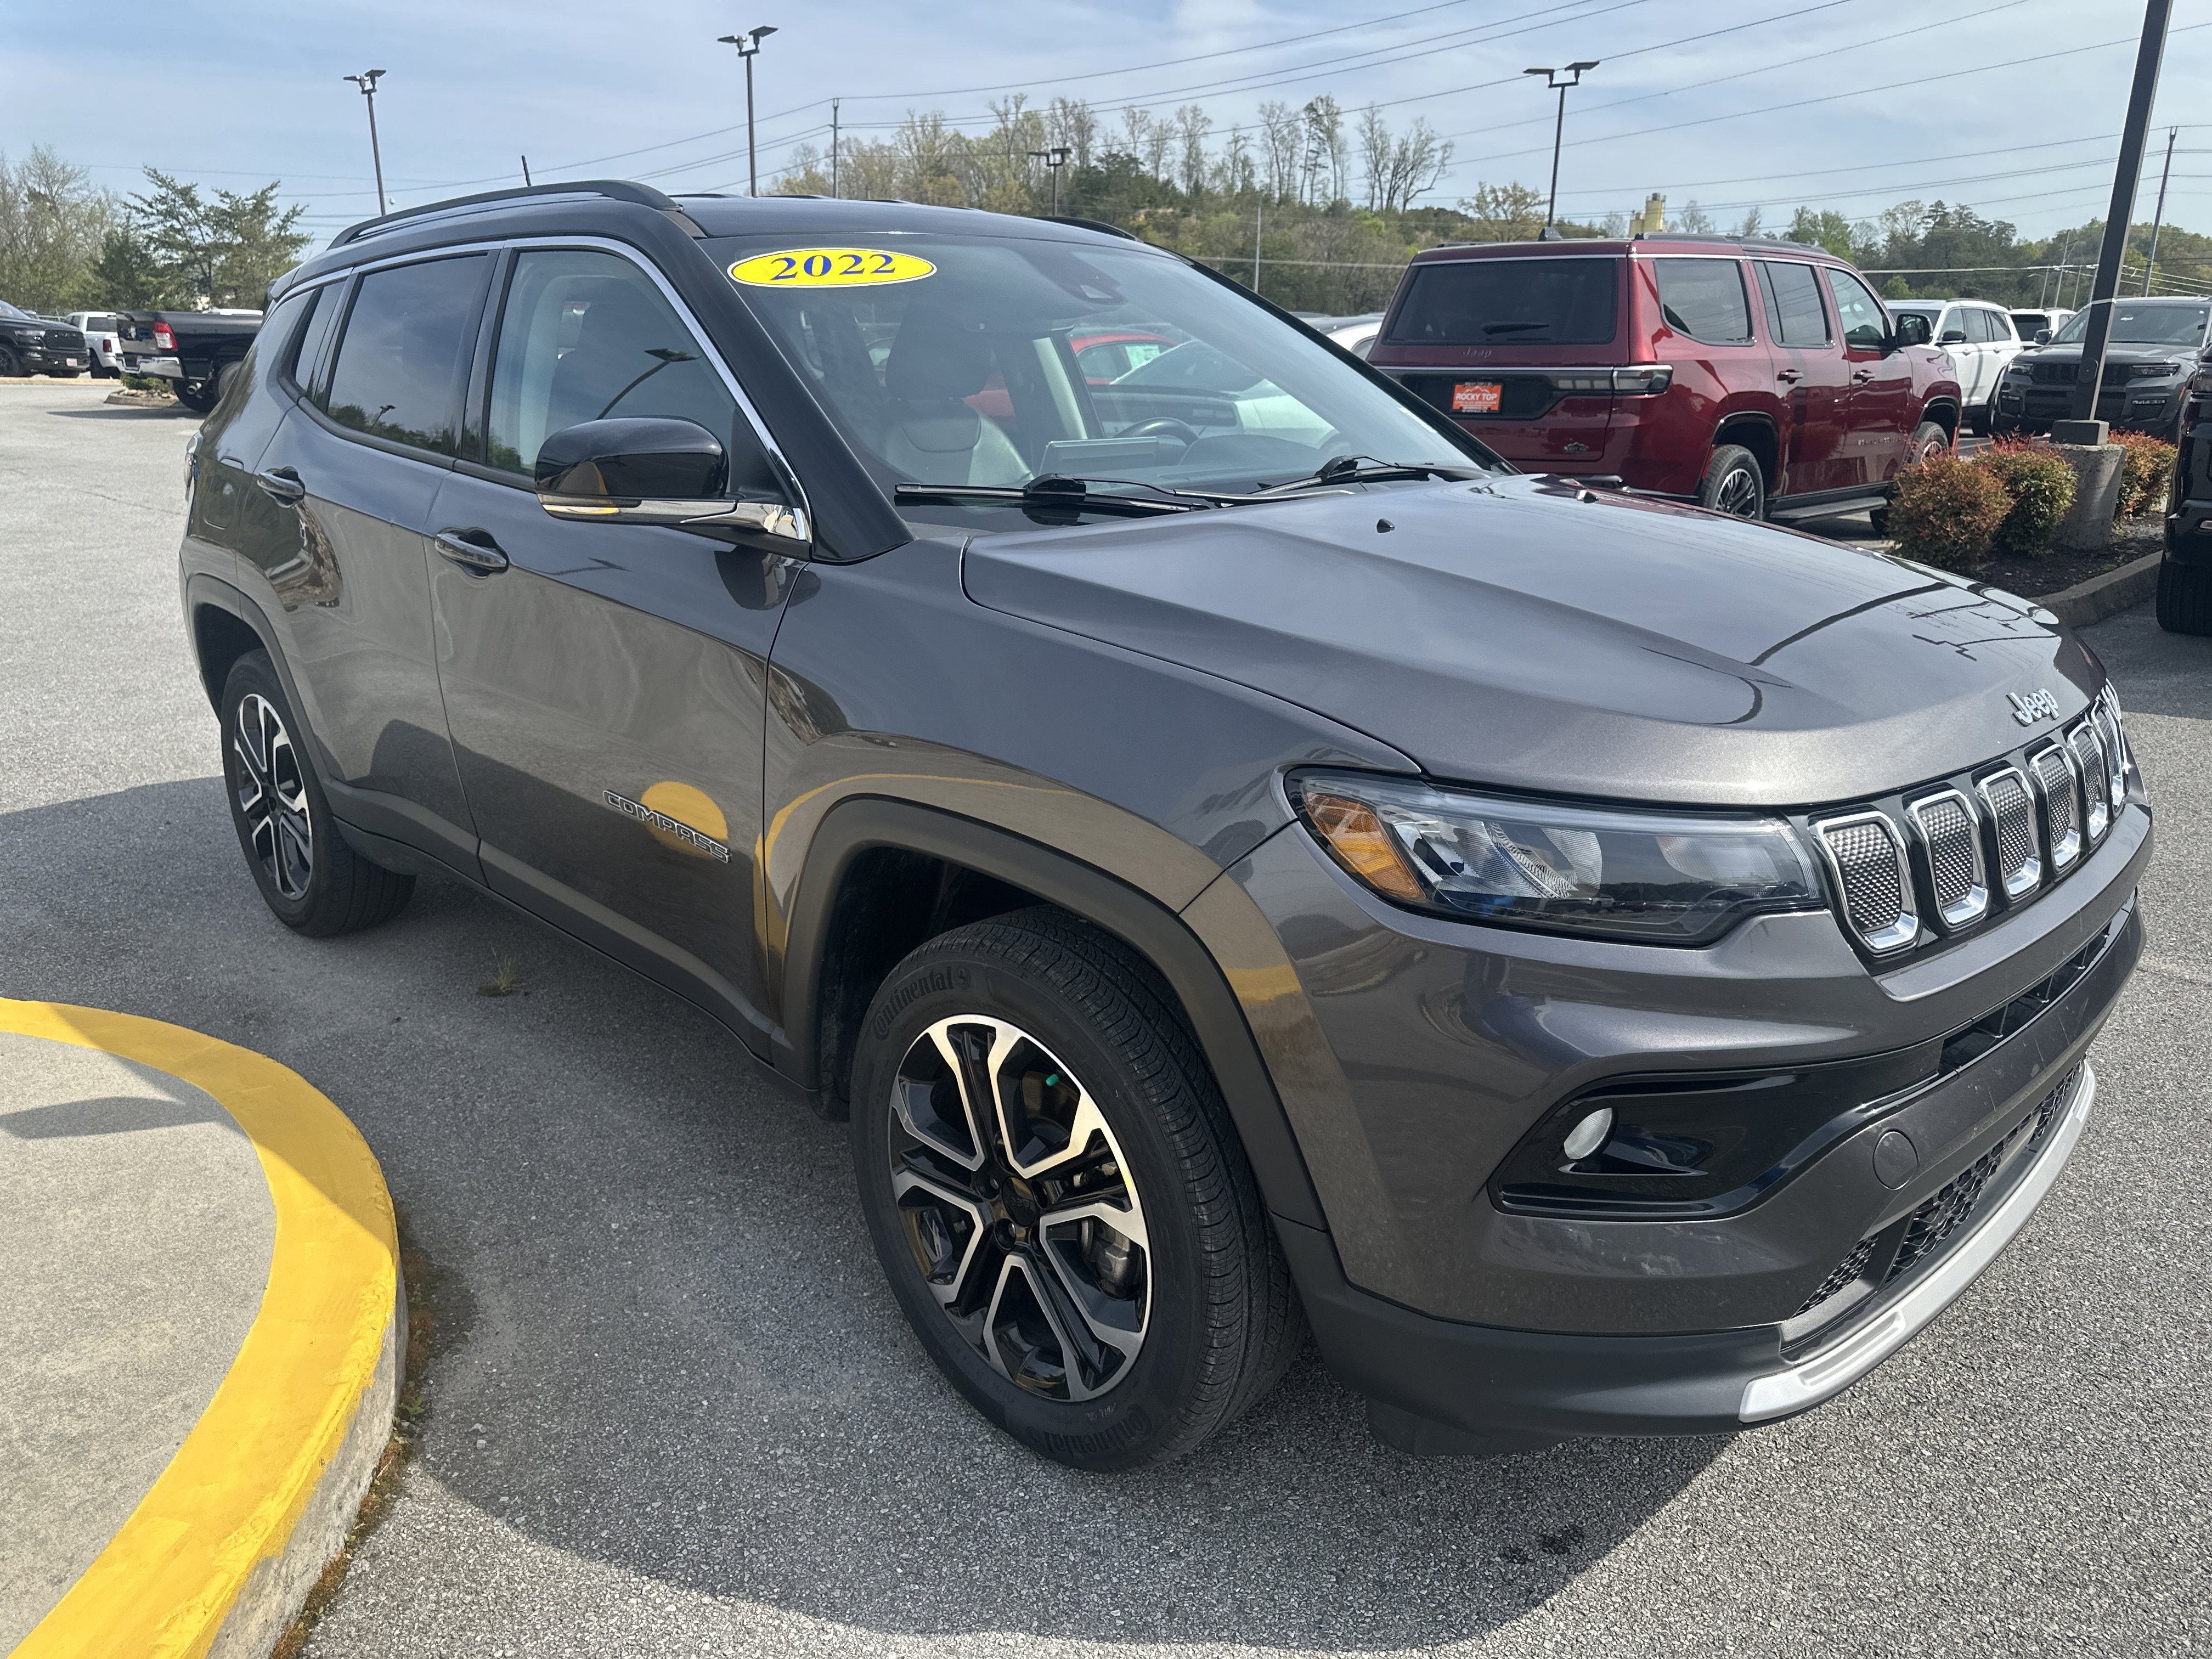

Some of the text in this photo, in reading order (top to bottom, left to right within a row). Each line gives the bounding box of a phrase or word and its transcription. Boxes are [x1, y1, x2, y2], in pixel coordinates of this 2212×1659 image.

[770, 254, 896, 280] 2022
[1455, 392, 1498, 401] ROCKY TOP
[2006, 687, 2059, 727] Jeep
[602, 789, 731, 864] COMPASS
[873, 966, 954, 1041] Continental
